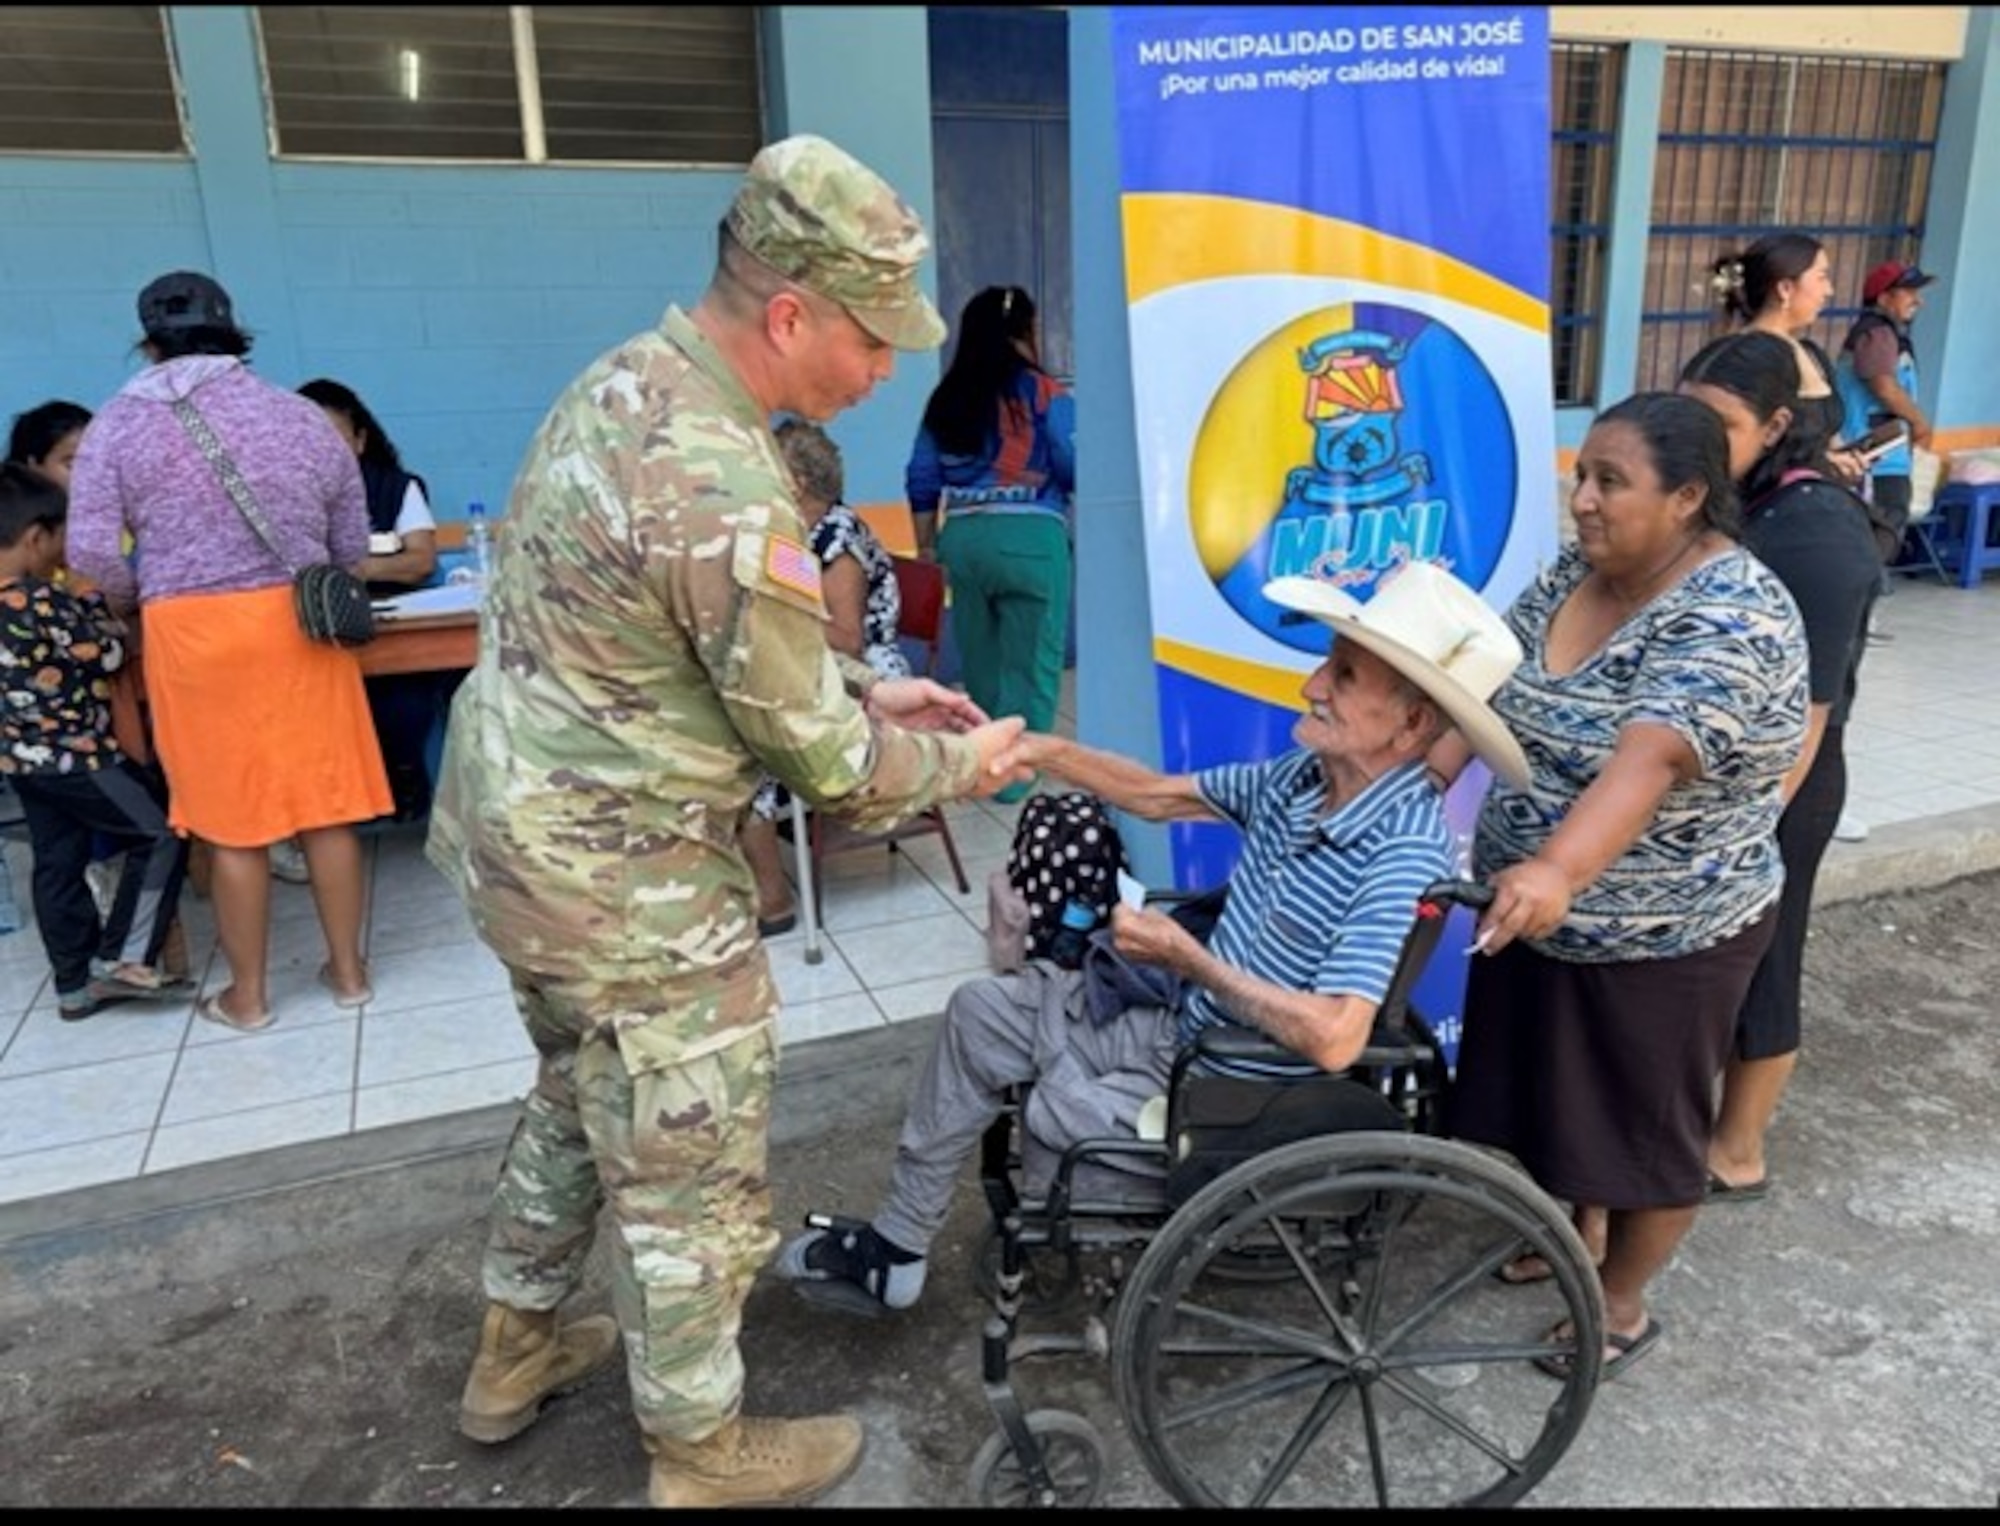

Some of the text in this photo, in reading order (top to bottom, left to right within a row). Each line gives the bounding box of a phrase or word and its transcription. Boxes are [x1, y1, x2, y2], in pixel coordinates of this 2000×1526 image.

[1139, 15, 1524, 65] MUNICIPALIDAD DE SAN JOSÉ
[1161, 54, 1505, 100] ¡Por una mejor calidad de vida!
[1269, 500, 1447, 578] MUNI
